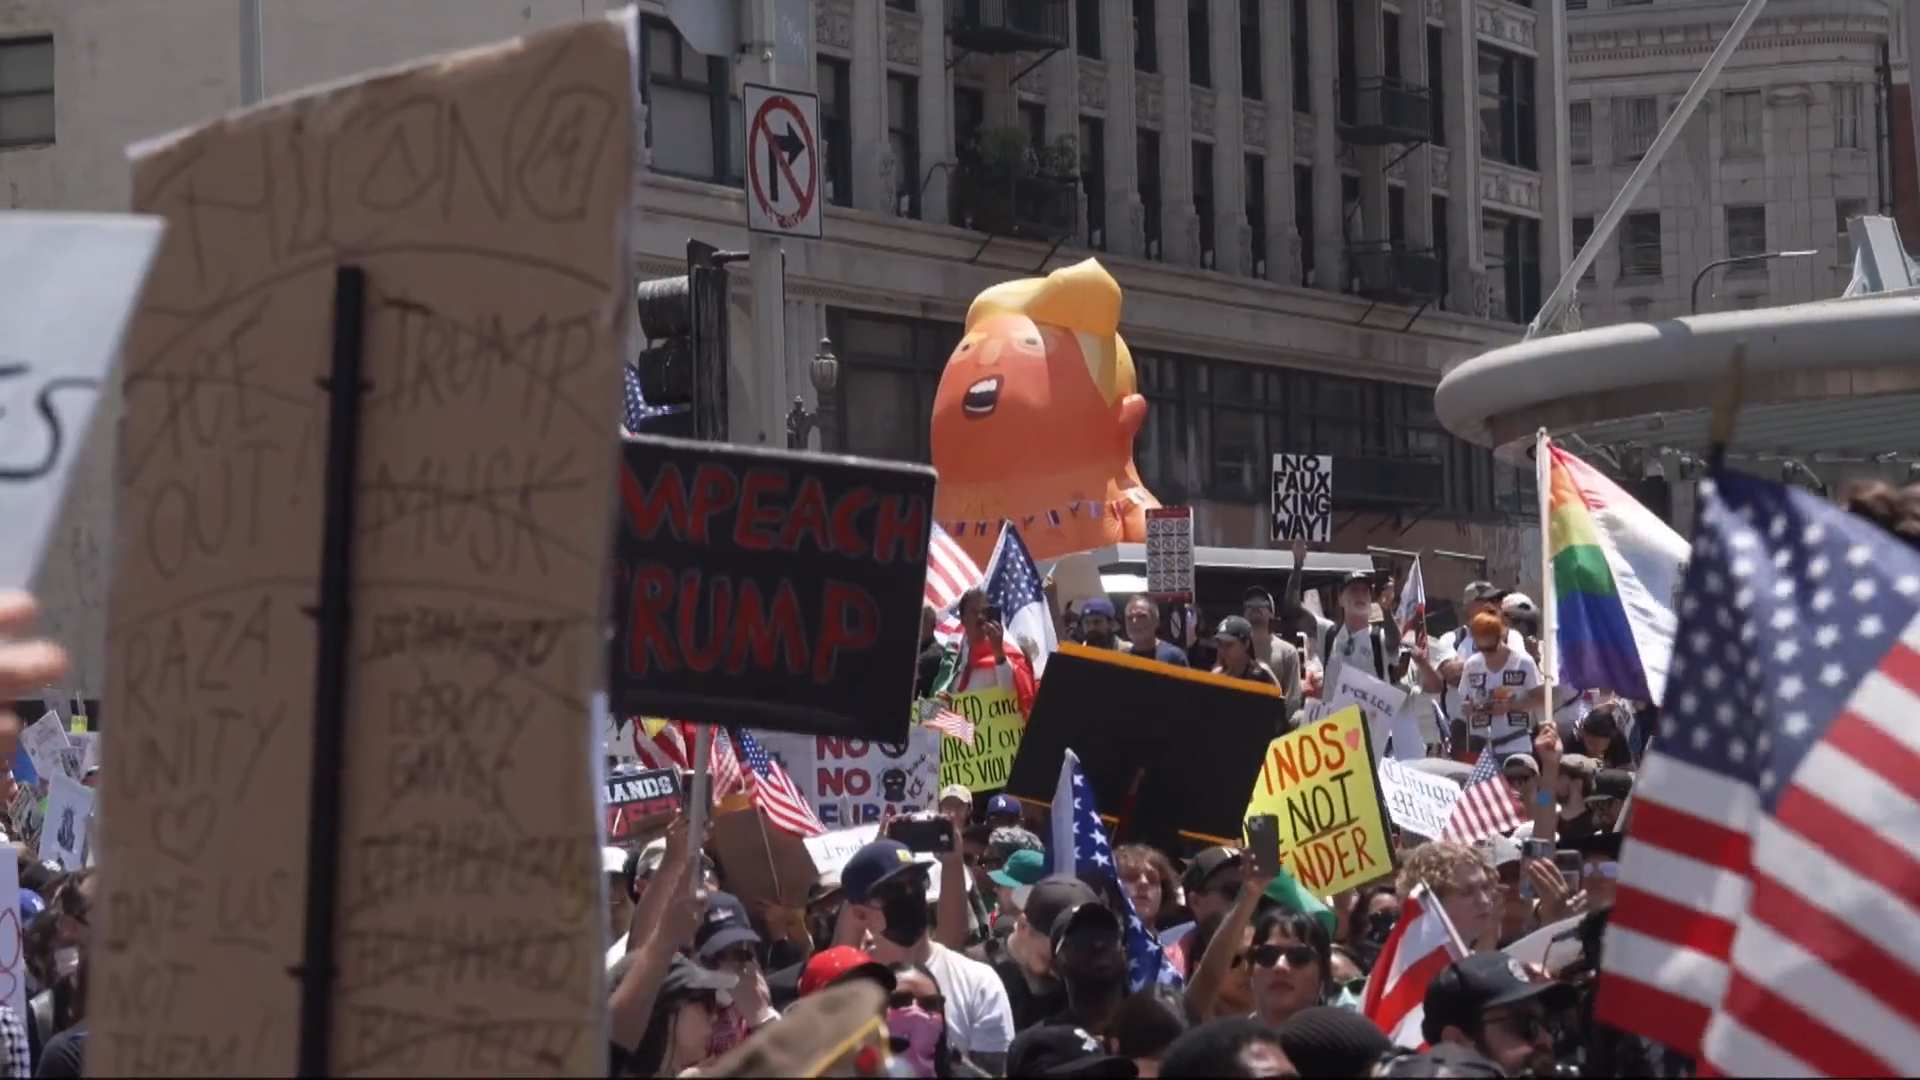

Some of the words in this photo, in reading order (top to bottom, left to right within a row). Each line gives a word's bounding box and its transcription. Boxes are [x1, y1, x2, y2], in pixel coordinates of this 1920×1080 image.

[1282, 455, 1319, 472] NO
[1274, 472, 1330, 493] FAUX
[1274, 493, 1331, 515] KING
[1272, 514, 1329, 542] WAY!
[122, 593, 272, 729] RAZA
[115, 697, 289, 810] UNITY
[816, 735, 870, 761] NO
[816, 767, 872, 798] NO
[1287, 769, 1355, 842] NOT
